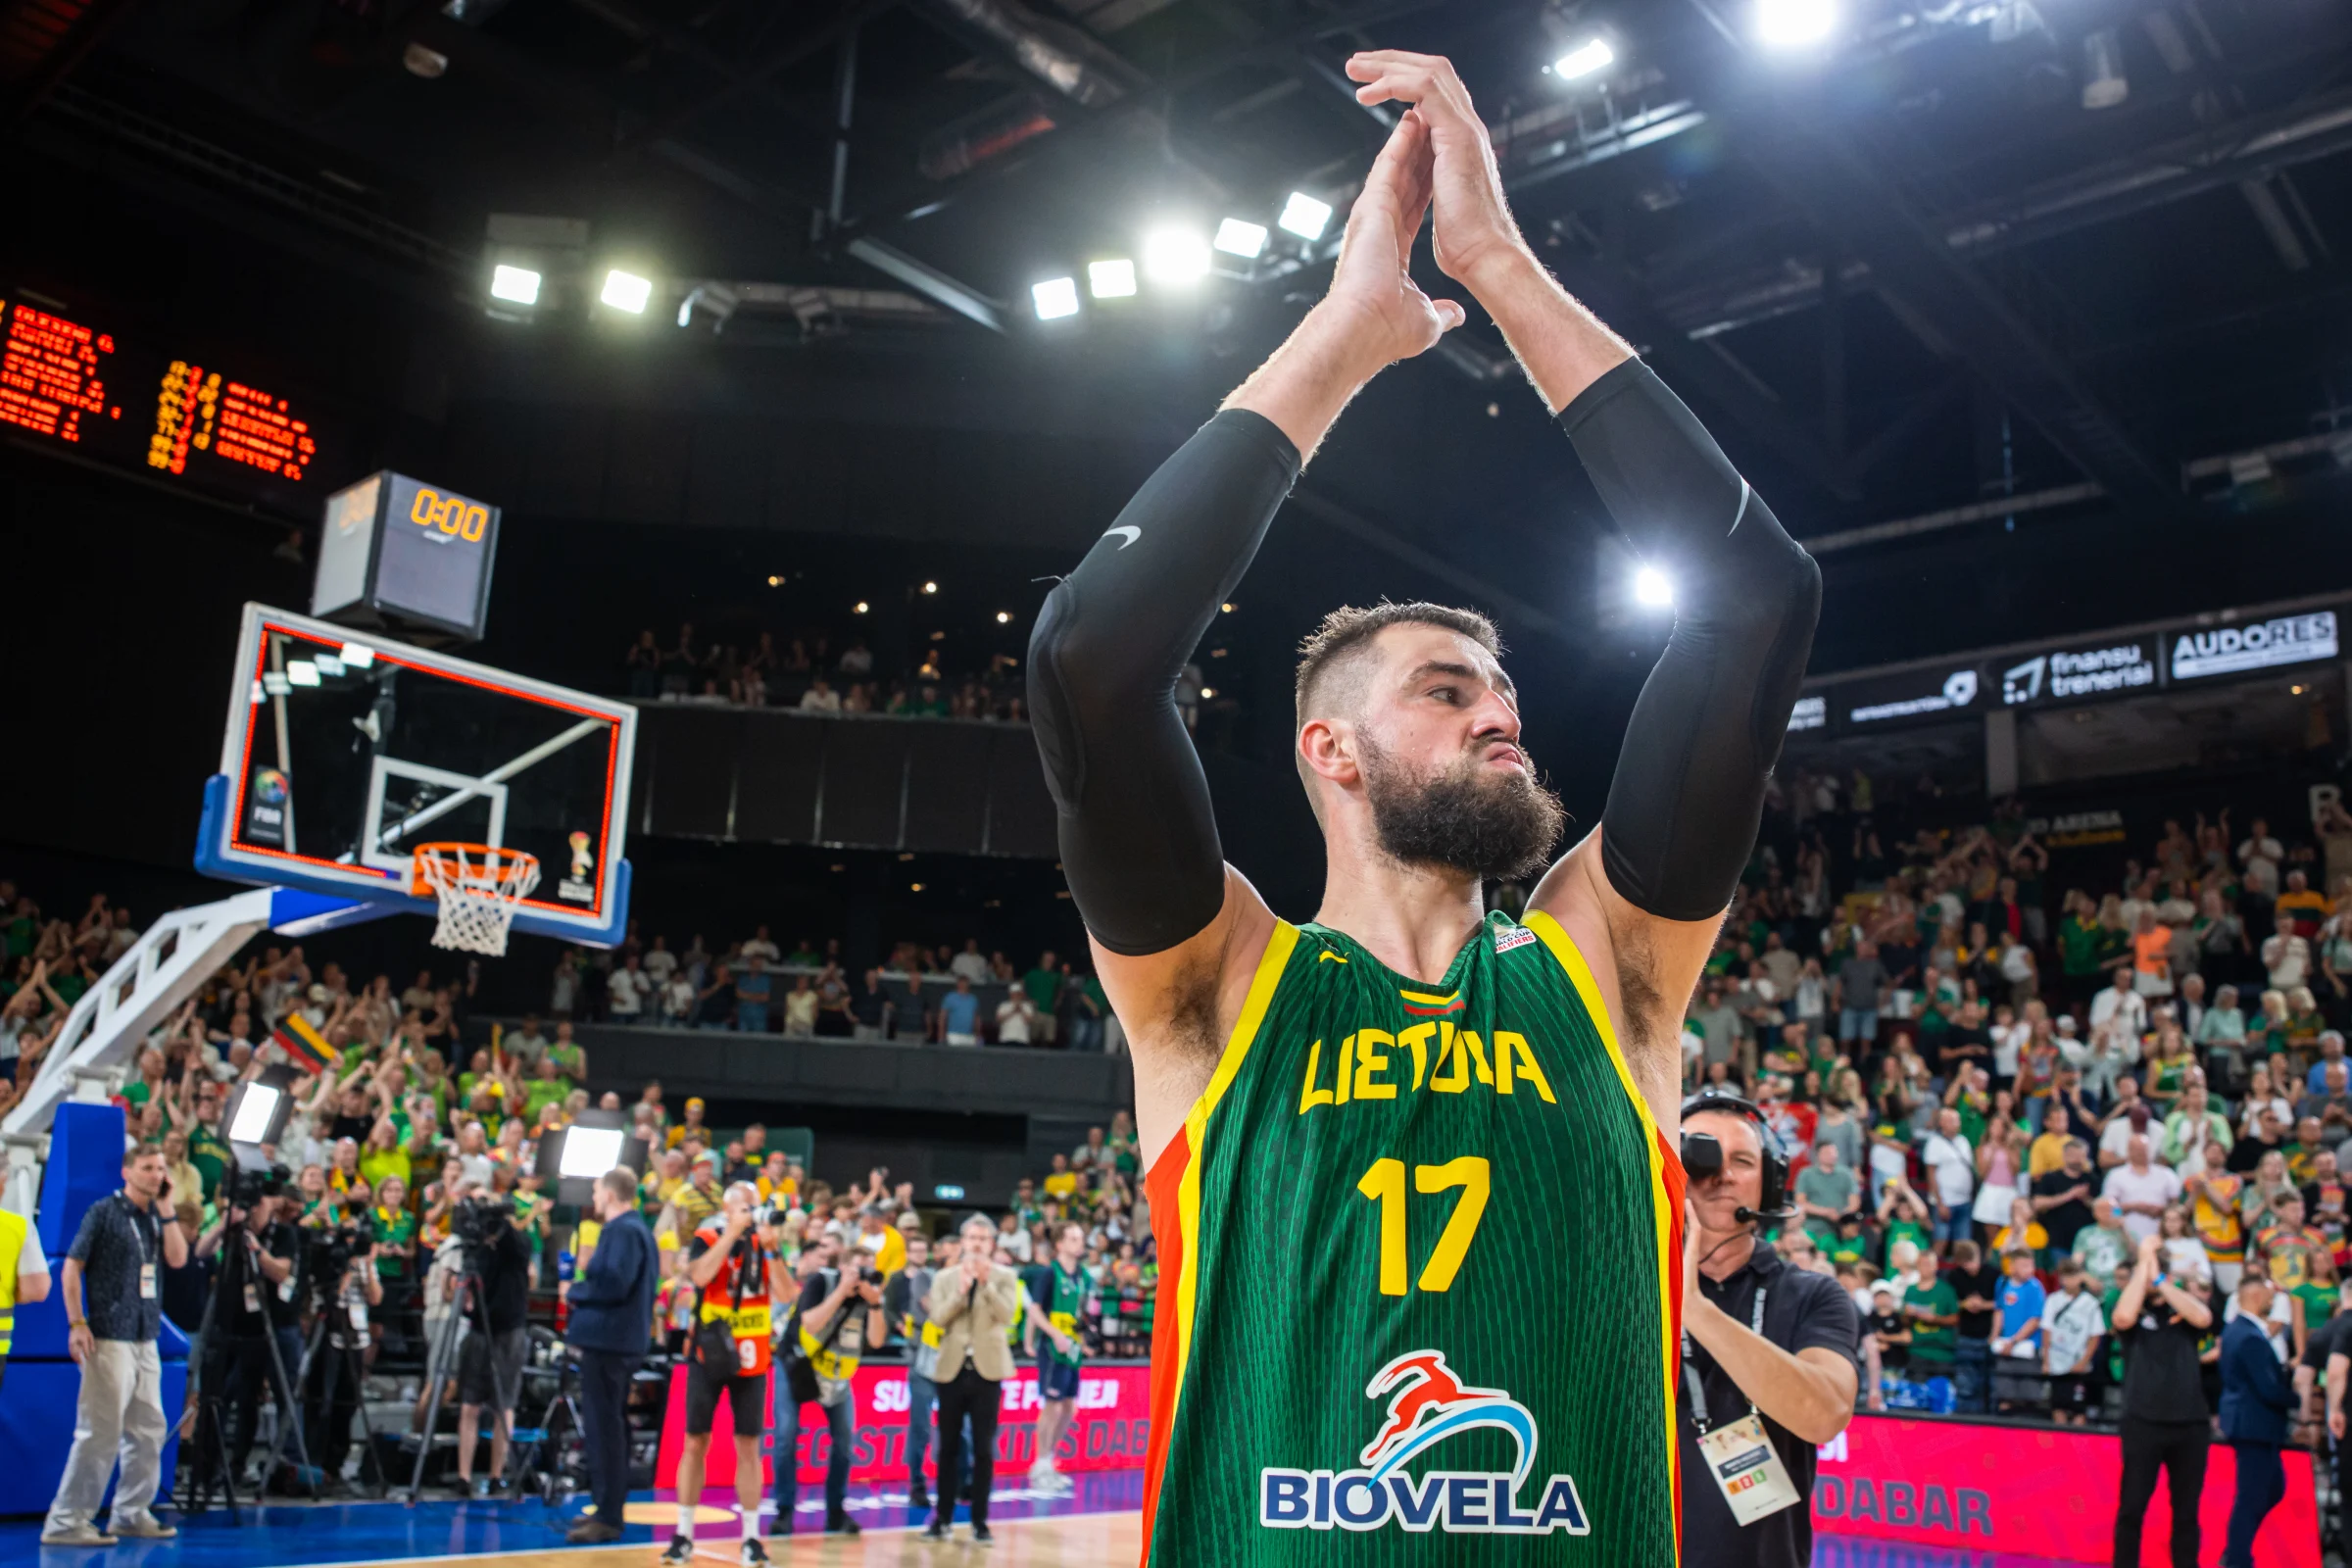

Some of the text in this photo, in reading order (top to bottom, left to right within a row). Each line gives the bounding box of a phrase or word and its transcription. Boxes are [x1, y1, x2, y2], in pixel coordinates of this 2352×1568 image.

[411, 488, 488, 543] 0:00
[2173, 615, 2332, 660] AUDORES
[1494, 935, 1534, 952] ALIFIERS
[1299, 1020, 1556, 1115] LIETUVA
[1357, 1156, 1491, 1296] 17
[1264, 1473, 1586, 1530] BIOVELA
[1814, 1474, 1993, 1536] DABAR
